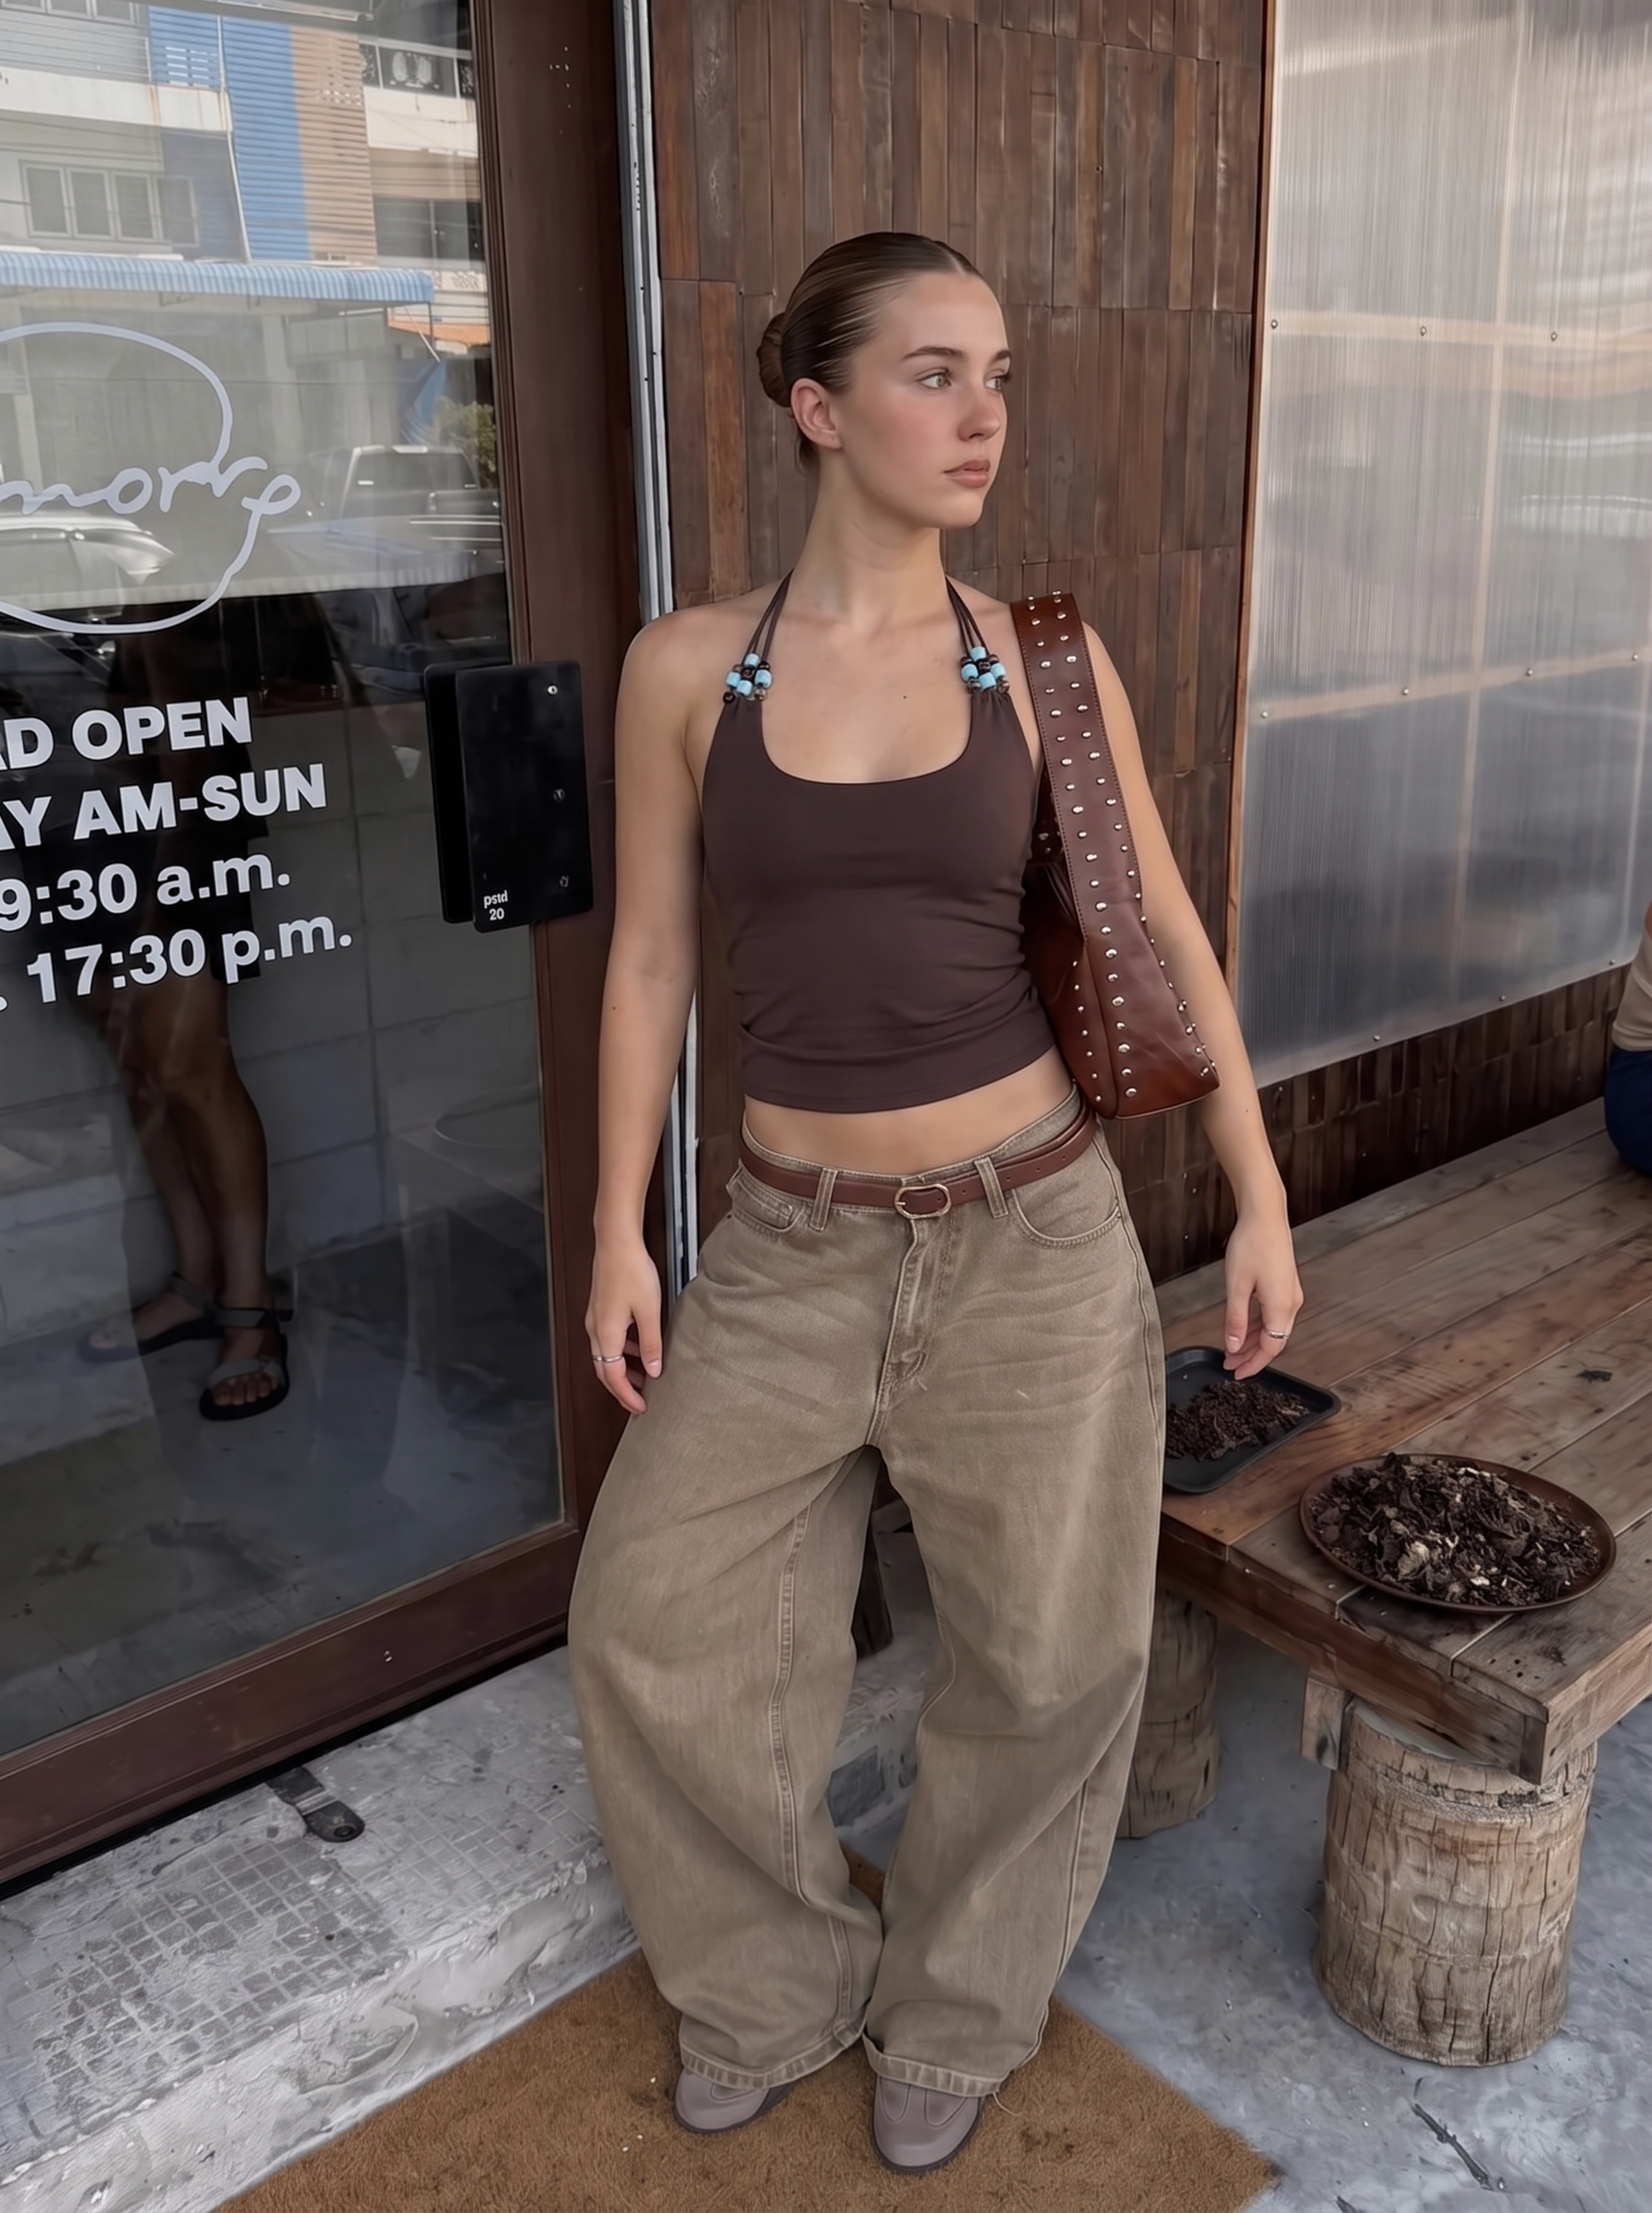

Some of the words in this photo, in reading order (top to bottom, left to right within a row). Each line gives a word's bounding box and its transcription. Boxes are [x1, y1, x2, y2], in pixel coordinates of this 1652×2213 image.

[0, 717, 54, 771] D
[72, 696, 252, 760] OPEN
[74, 763, 326, 840] AM-SUN
[157, 854, 290, 905] a.m.
[483, 889, 509, 909] pstd
[489, 907, 505, 921] 20
[27, 929, 206, 1003] 17:30
[221, 916, 352, 984] p.m.
